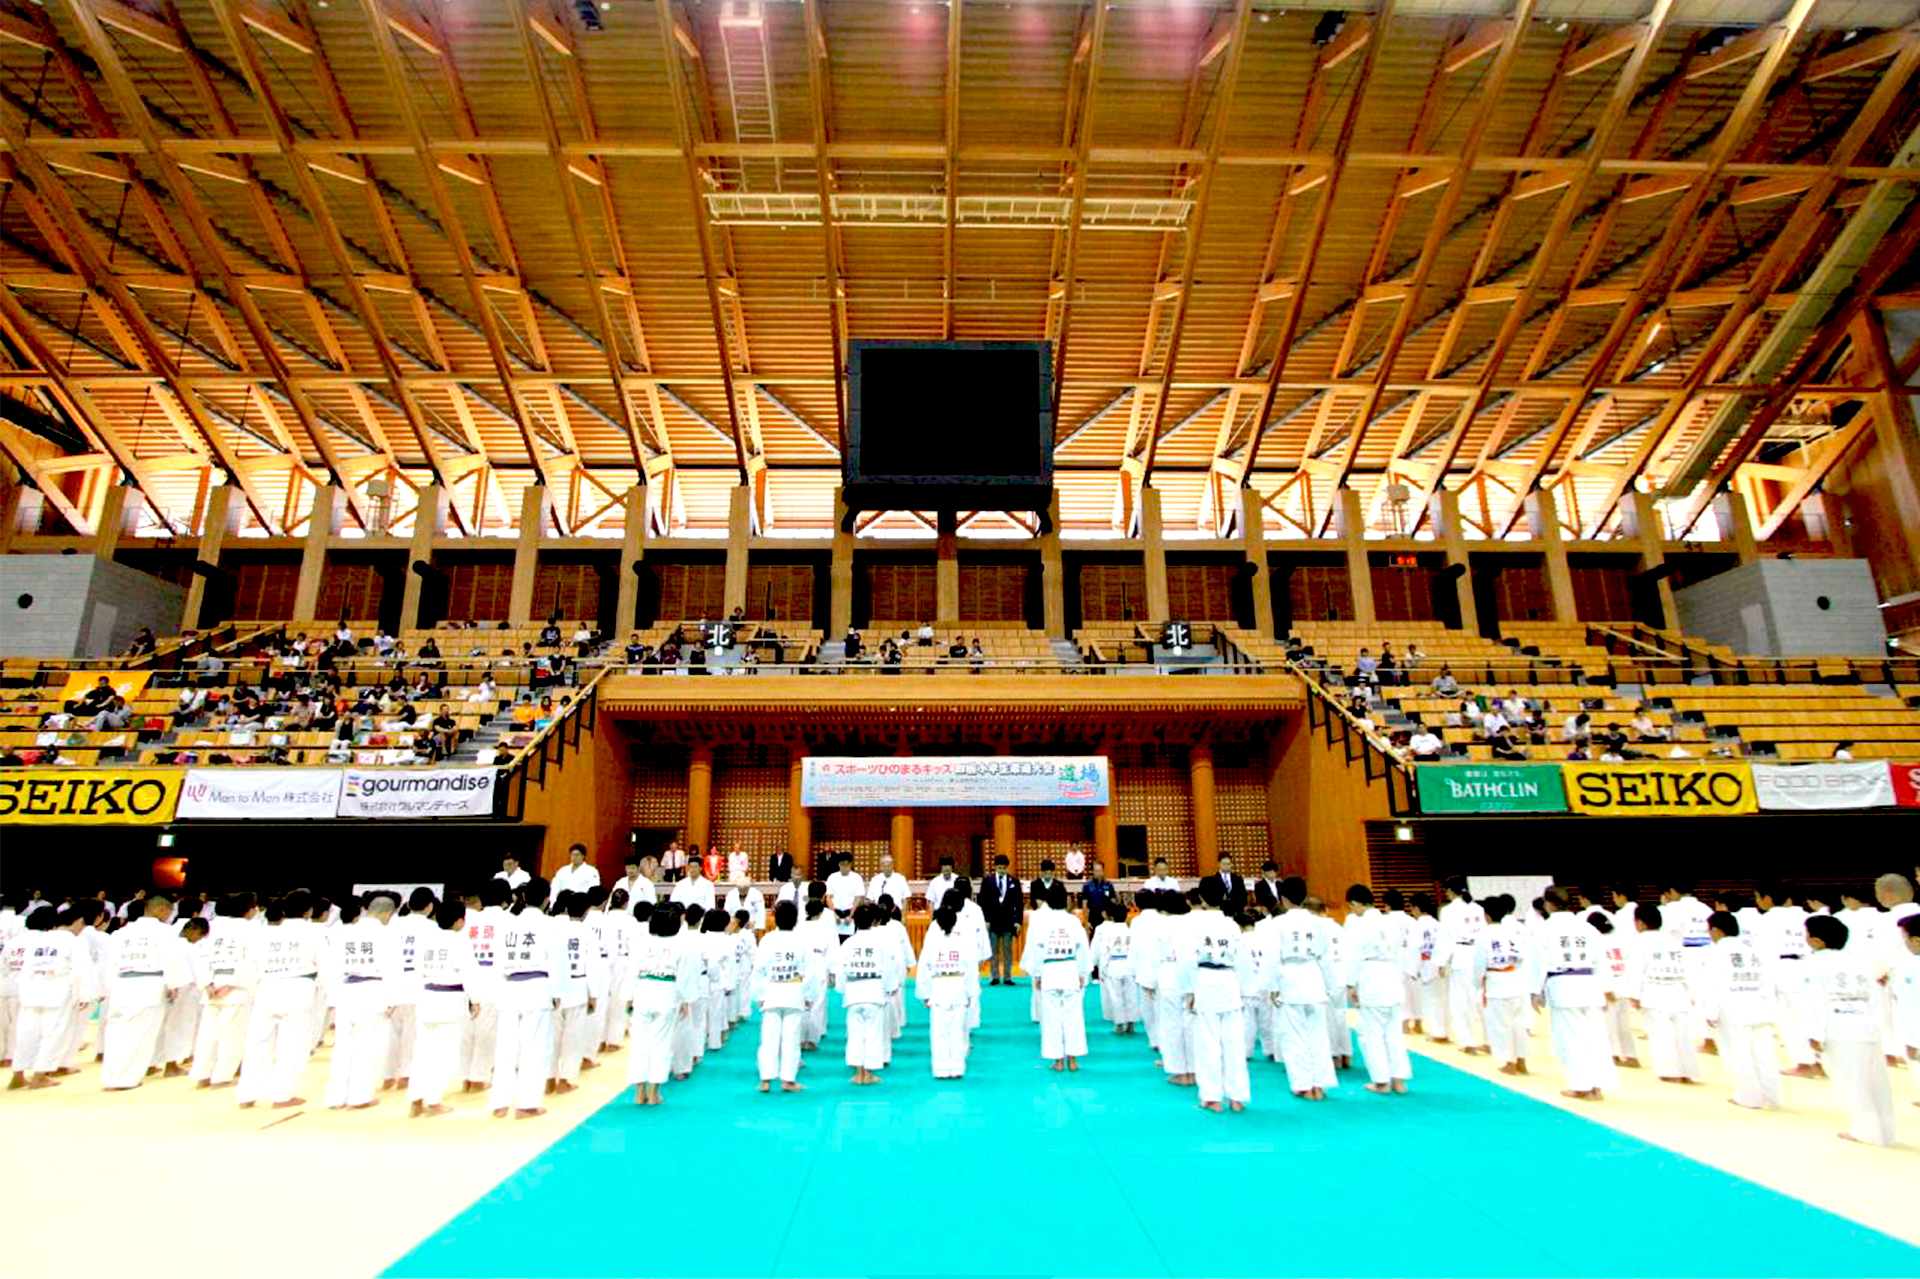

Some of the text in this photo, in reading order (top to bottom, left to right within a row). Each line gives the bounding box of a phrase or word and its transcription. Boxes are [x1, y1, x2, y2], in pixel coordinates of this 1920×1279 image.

[706, 624, 730, 645] 北
[1166, 624, 1189, 645] 北
[361, 775, 490, 797] gourmandise
[1444, 777, 1539, 798] BATHCLIN
[1576, 773, 1743, 807] SEIKO
[0, 780, 166, 815] SEIKO
[208, 791, 236, 804] Man
[238, 794, 250, 804] to
[251, 791, 280, 803] Man
[504, 931, 537, 948] 山本
